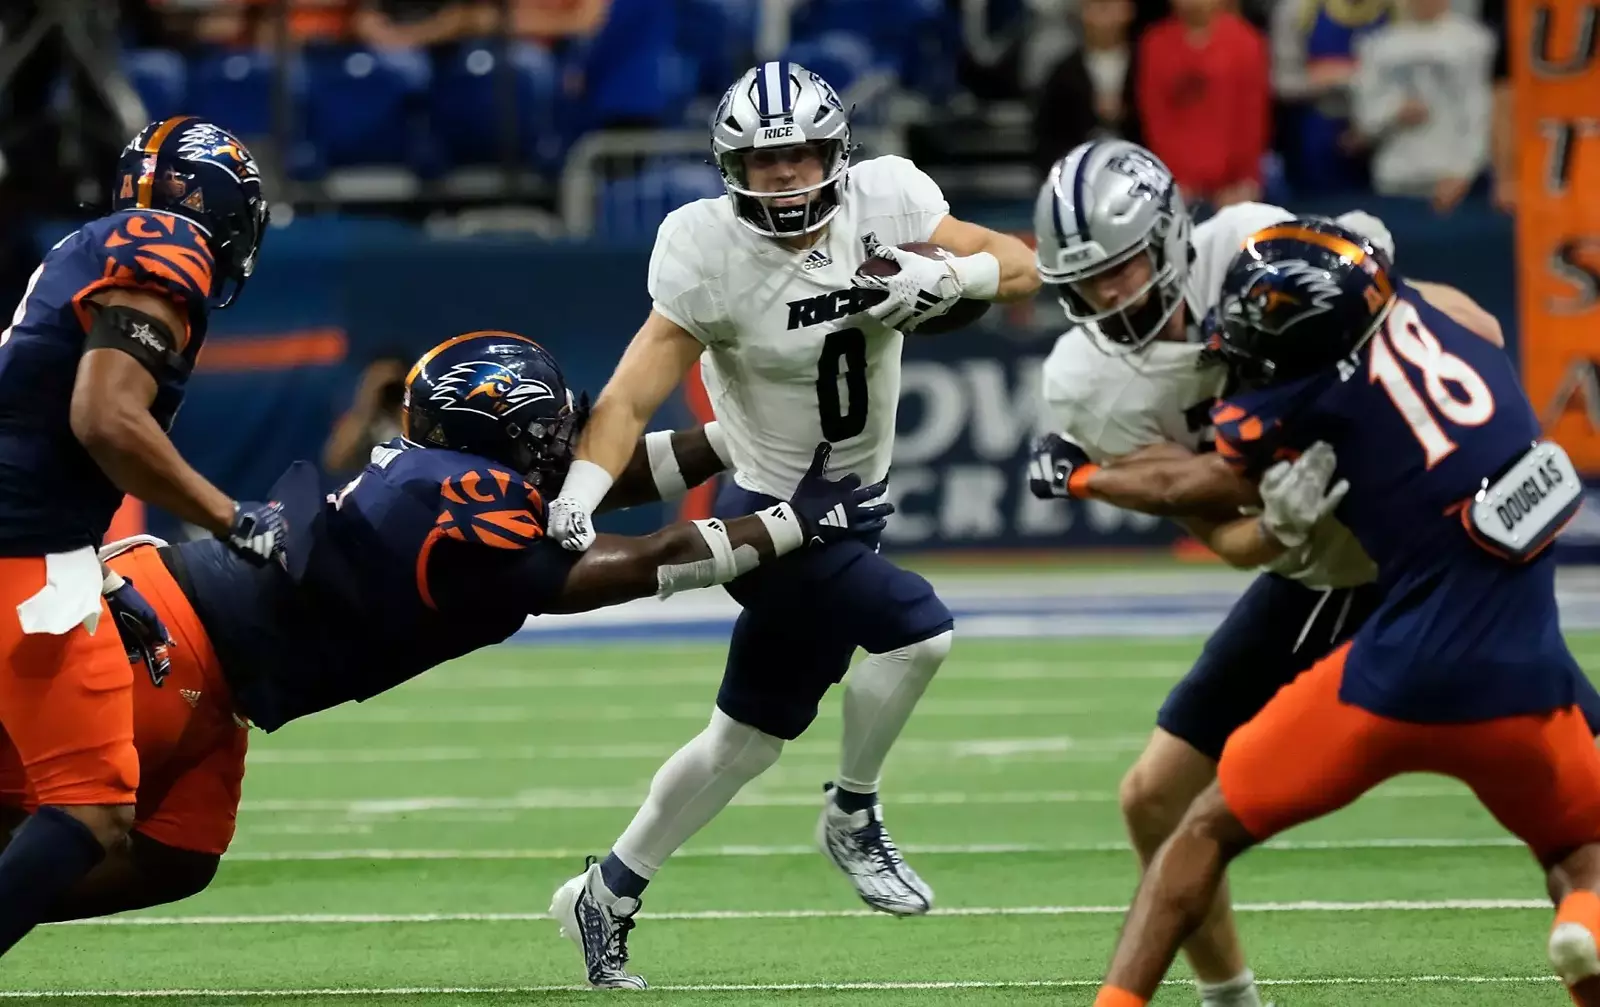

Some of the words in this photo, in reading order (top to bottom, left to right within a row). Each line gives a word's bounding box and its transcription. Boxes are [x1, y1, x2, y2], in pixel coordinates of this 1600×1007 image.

[764, 127, 793, 139] RICE
[816, 327, 868, 442] 0
[1369, 299, 1496, 470] 18
[1497, 458, 1563, 531] DOUGLAS
